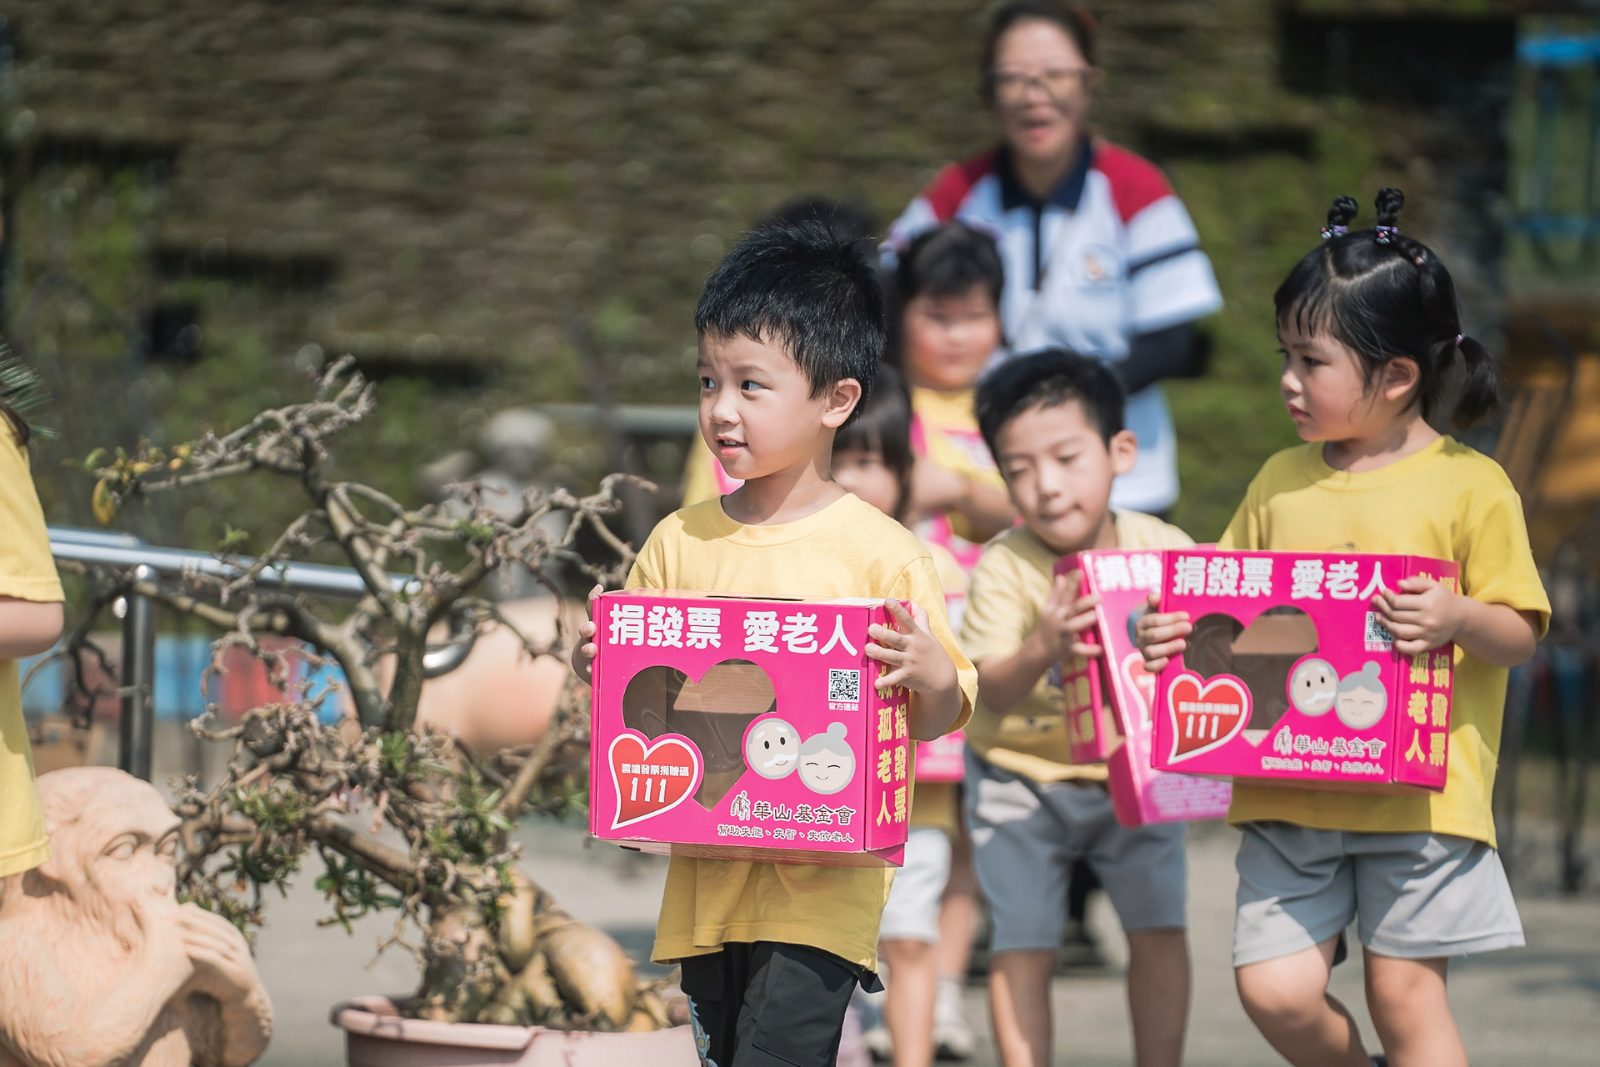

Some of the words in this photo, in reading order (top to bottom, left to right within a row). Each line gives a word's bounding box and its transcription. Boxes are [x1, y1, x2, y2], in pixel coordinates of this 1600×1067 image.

[1173, 556, 1273, 598] 捐發票
[1291, 557, 1387, 601] 愛老人
[608, 603, 722, 650] 捐發票
[742, 610, 858, 657] 愛老人
[1185, 714, 1220, 740] 111
[1293, 734, 1386, 760] 華山基金會
[631, 777, 667, 803] 111
[752, 800, 856, 826] 華山基金會
